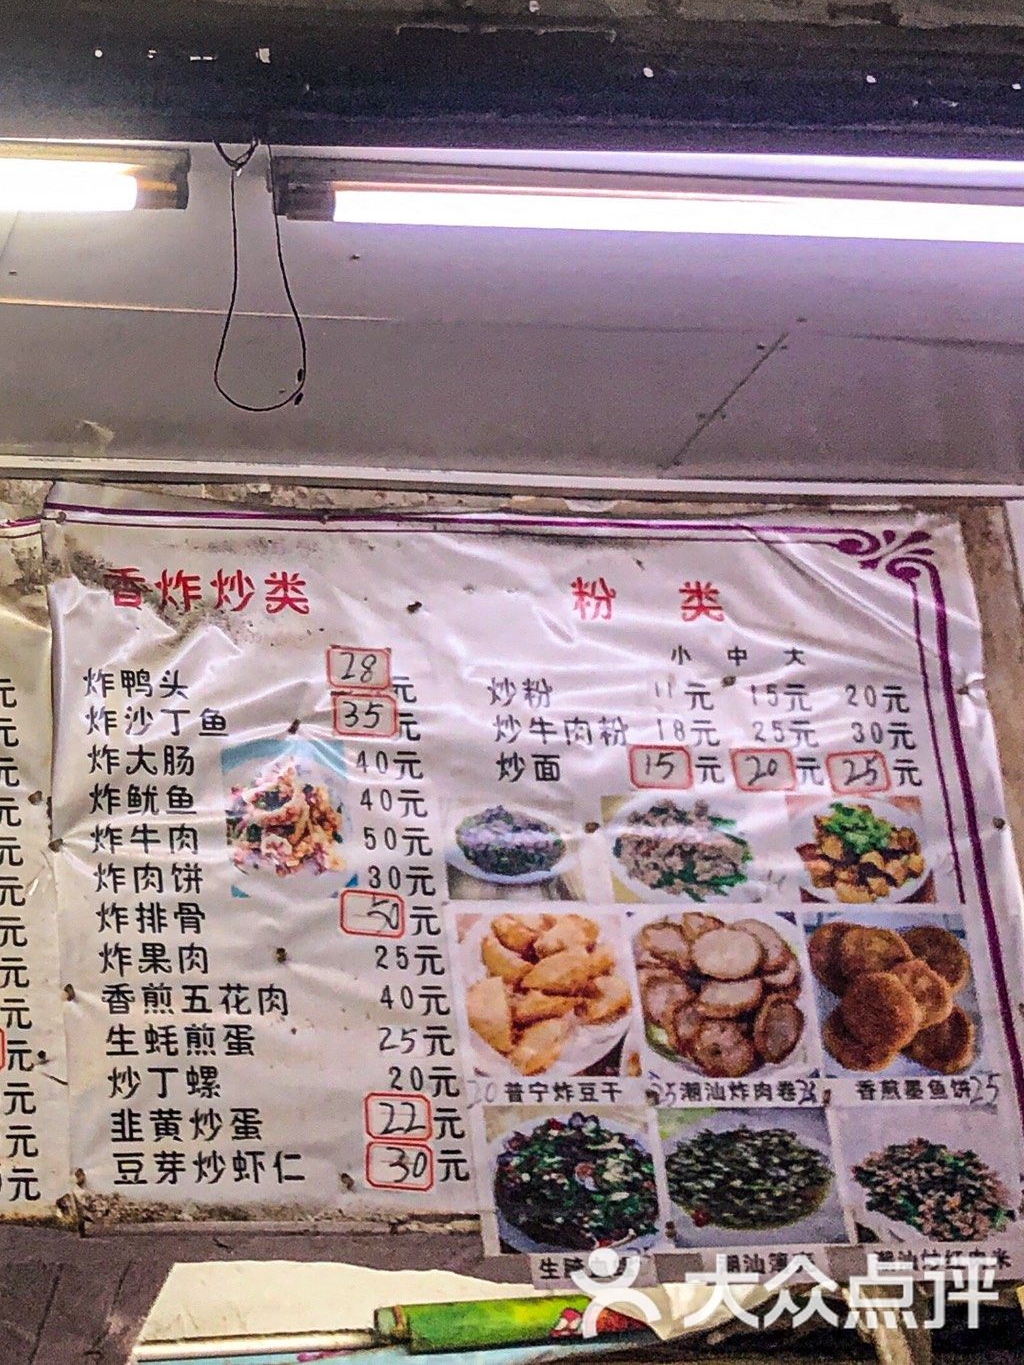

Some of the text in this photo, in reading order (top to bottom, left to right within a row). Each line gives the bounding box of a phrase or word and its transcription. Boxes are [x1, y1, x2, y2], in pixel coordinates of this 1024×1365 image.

[104, 567, 310, 615] 香炸炒类
[672, 645, 804, 667] 小 中 大
[83, 668, 188, 699] 炸鸭头
[488, 677, 553, 708] 炒粉
[750, 683, 812, 712] 15元
[845, 685, 910, 714] 20元
[86, 706, 228, 736] 炸沙丁鱼
[493, 714, 916, 750] 炒牛肉粉 18元 25元 30元
[88, 744, 423, 780] 炸大肠 40元
[496, 752, 560, 782] 炒面
[90, 784, 427, 818] 炸鱿鱼 40元
[91, 824, 432, 856] 炸牛肉 50元
[95, 862, 436, 896] 炸肉饼 30元
[96, 902, 205, 935] 炸排骨
[100, 941, 446, 976] 炸果肉 25元
[102, 984, 450, 1017] 香煎五花肉 40元
[106, 1023, 255, 1057] 生蚝煎蛋
[108, 1066, 460, 1099] 炒丁螺 20元
[505, 1082, 623, 1103] 普宁炸豆干
[680, 1080, 797, 1102] 潮汕炸肉卷
[856, 1079, 971, 1102] 香煎墨鱼饼
[111, 1108, 263, 1142] 韭黄炒蛋
[113, 1150, 304, 1184] 豆芽炒虾仁
